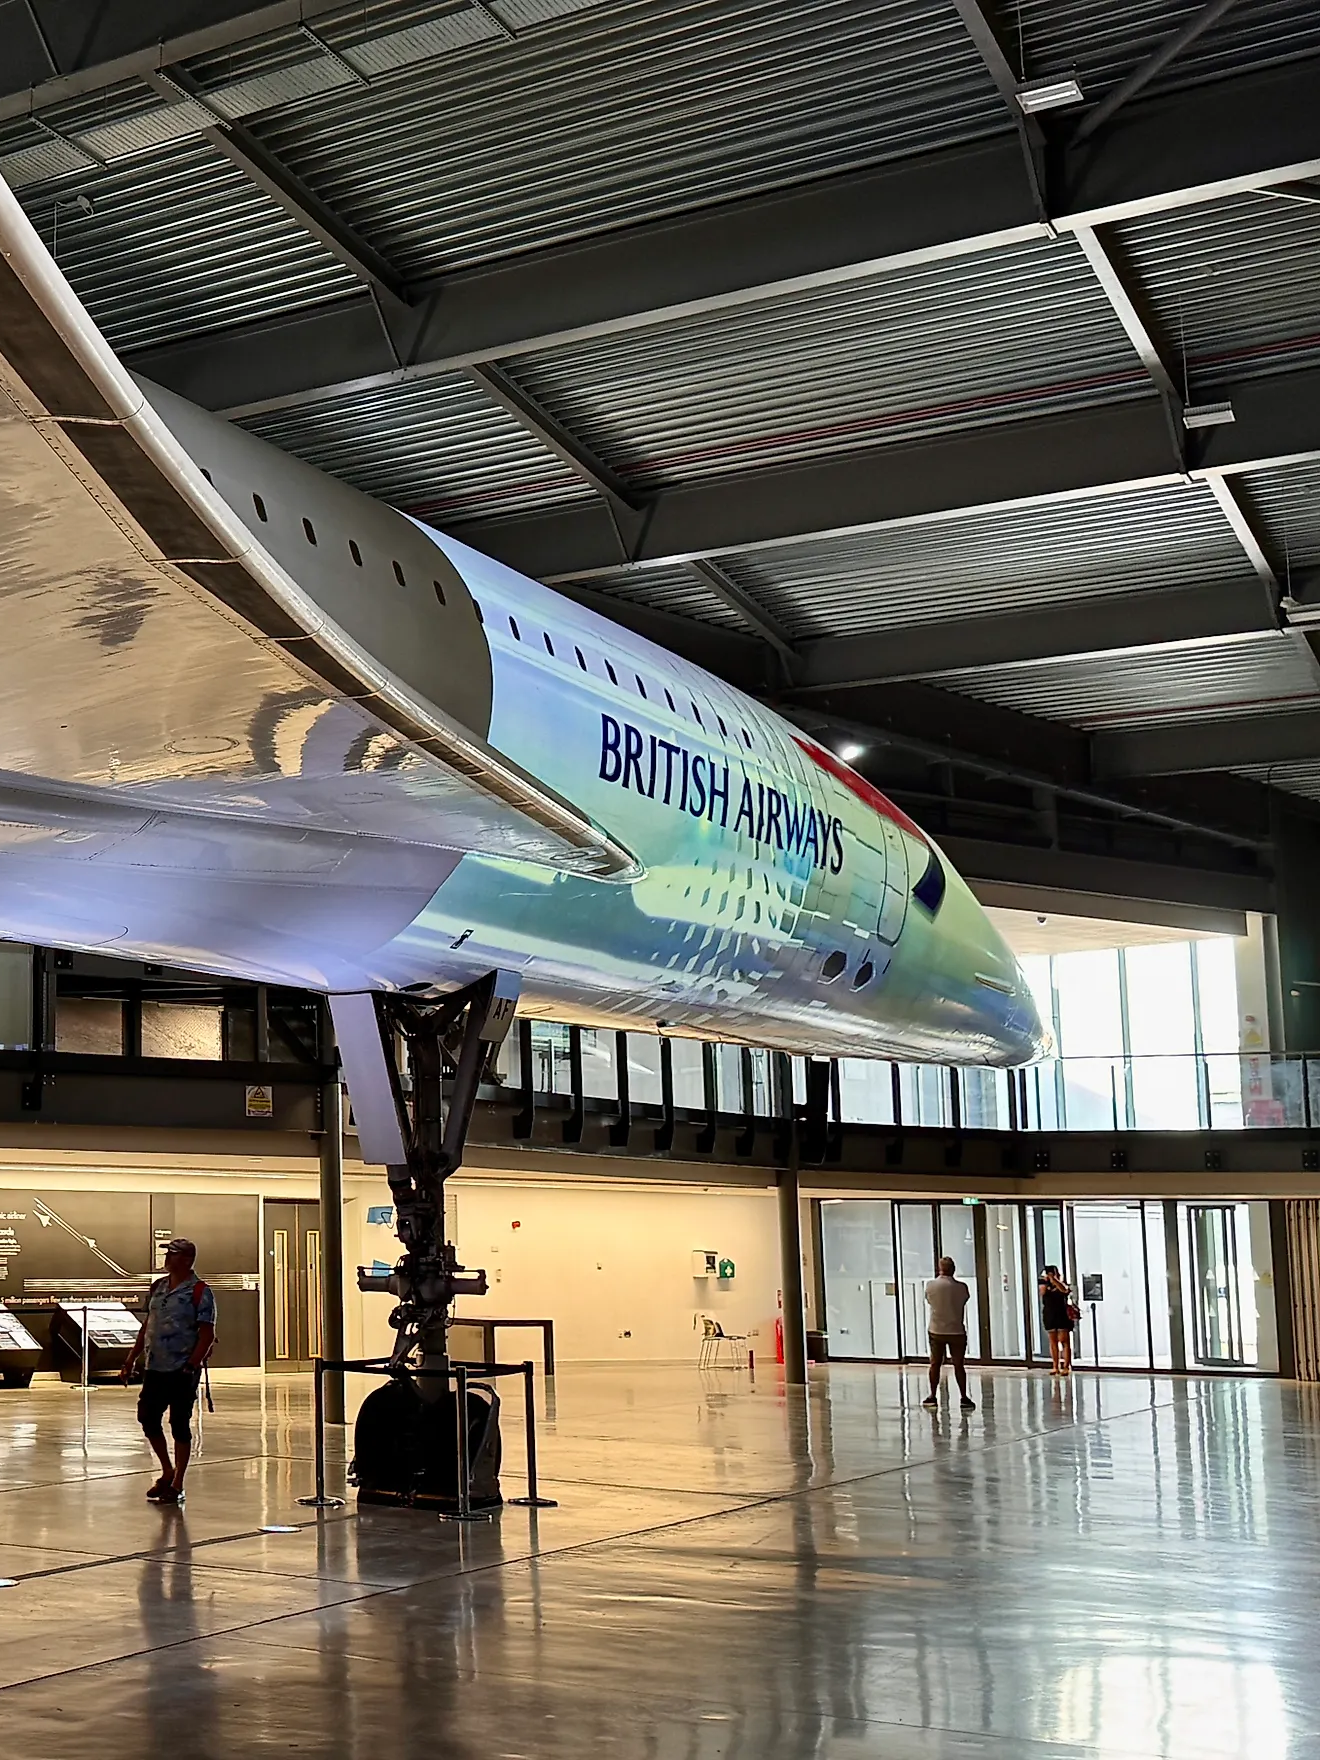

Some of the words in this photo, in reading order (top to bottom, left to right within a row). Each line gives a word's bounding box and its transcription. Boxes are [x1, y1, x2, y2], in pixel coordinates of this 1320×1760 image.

[598, 712, 730, 828] BRITISH
[733, 777, 844, 876] AIRWAYS
[492, 997, 512, 1020] AF
